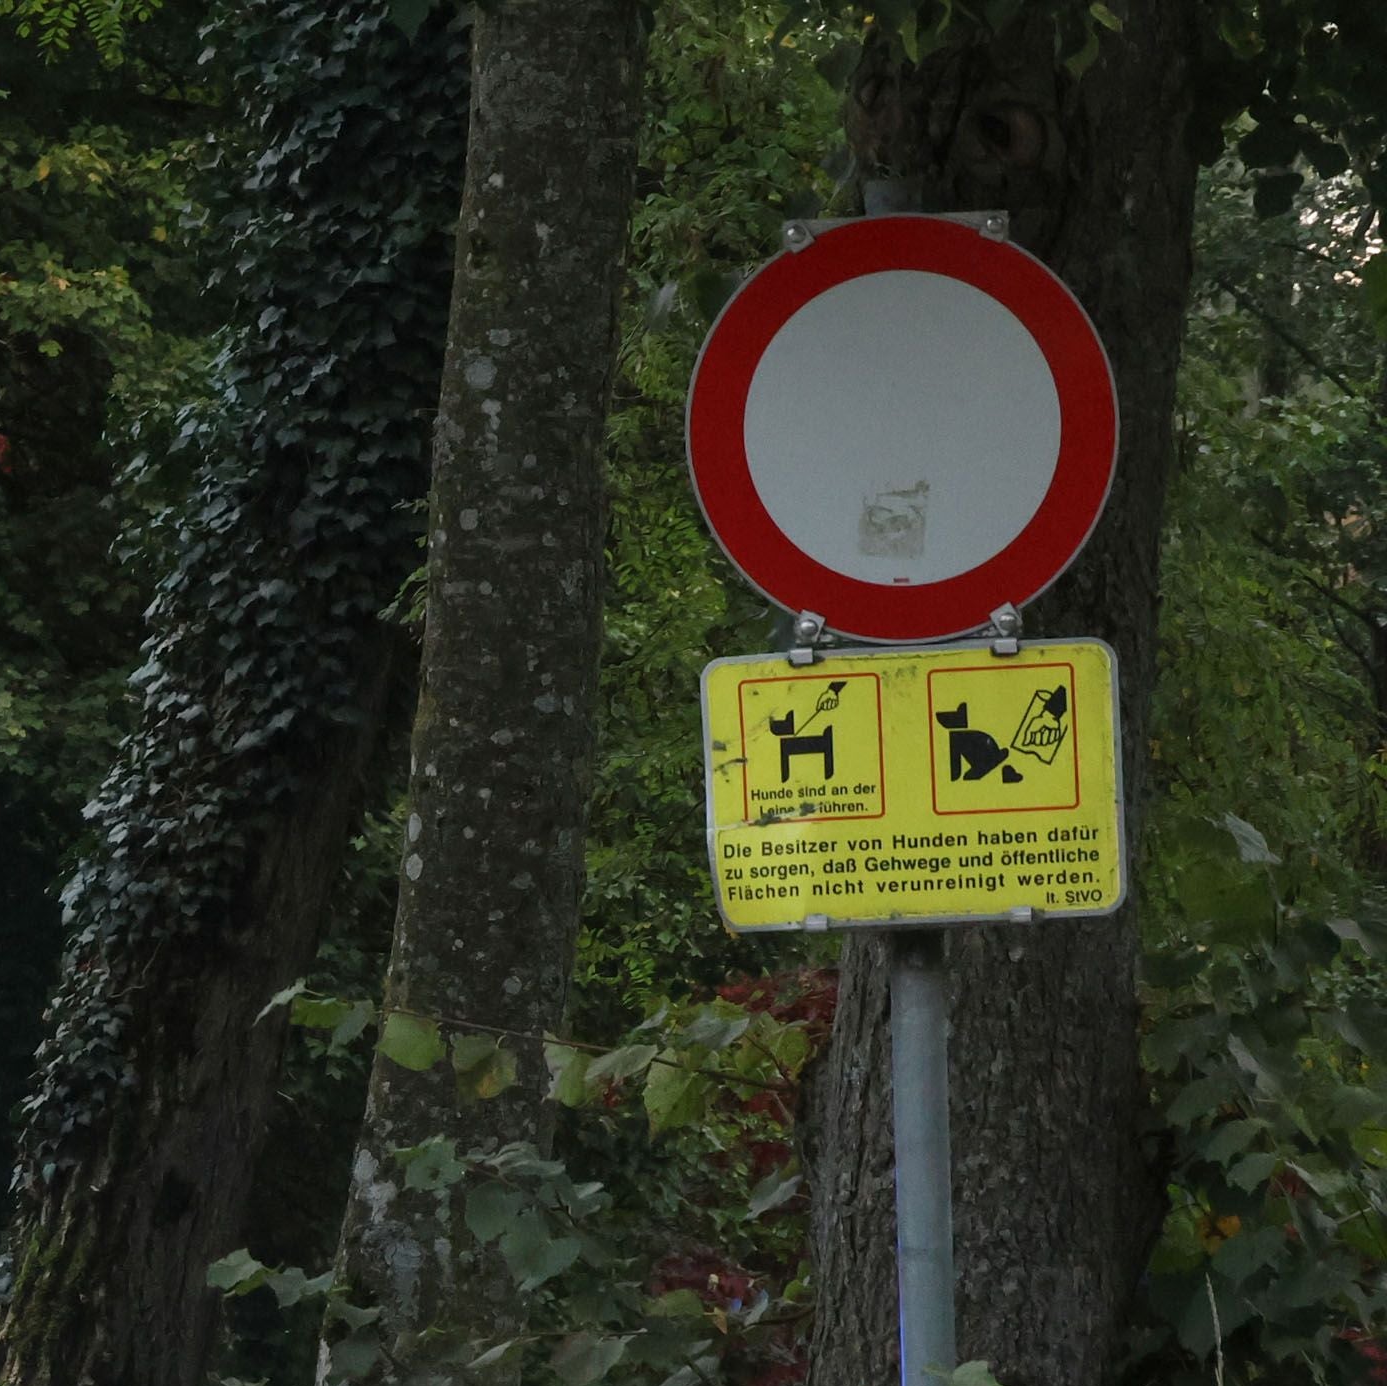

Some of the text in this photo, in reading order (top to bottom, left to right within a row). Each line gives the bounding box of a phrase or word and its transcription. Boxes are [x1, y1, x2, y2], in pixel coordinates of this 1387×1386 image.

[751, 783, 876, 801] Hunde sind an der
[819, 801, 869, 814] führen.
[724, 825, 1100, 859] Die Besitzer von Hunden haben dafür
[725, 847, 1100, 881] zu sorgen, daß Gehwege und öffentliche
[728, 869, 1101, 902] Flächen nicht verunreinigt werden.
[1065, 888, 1103, 905] StVO
